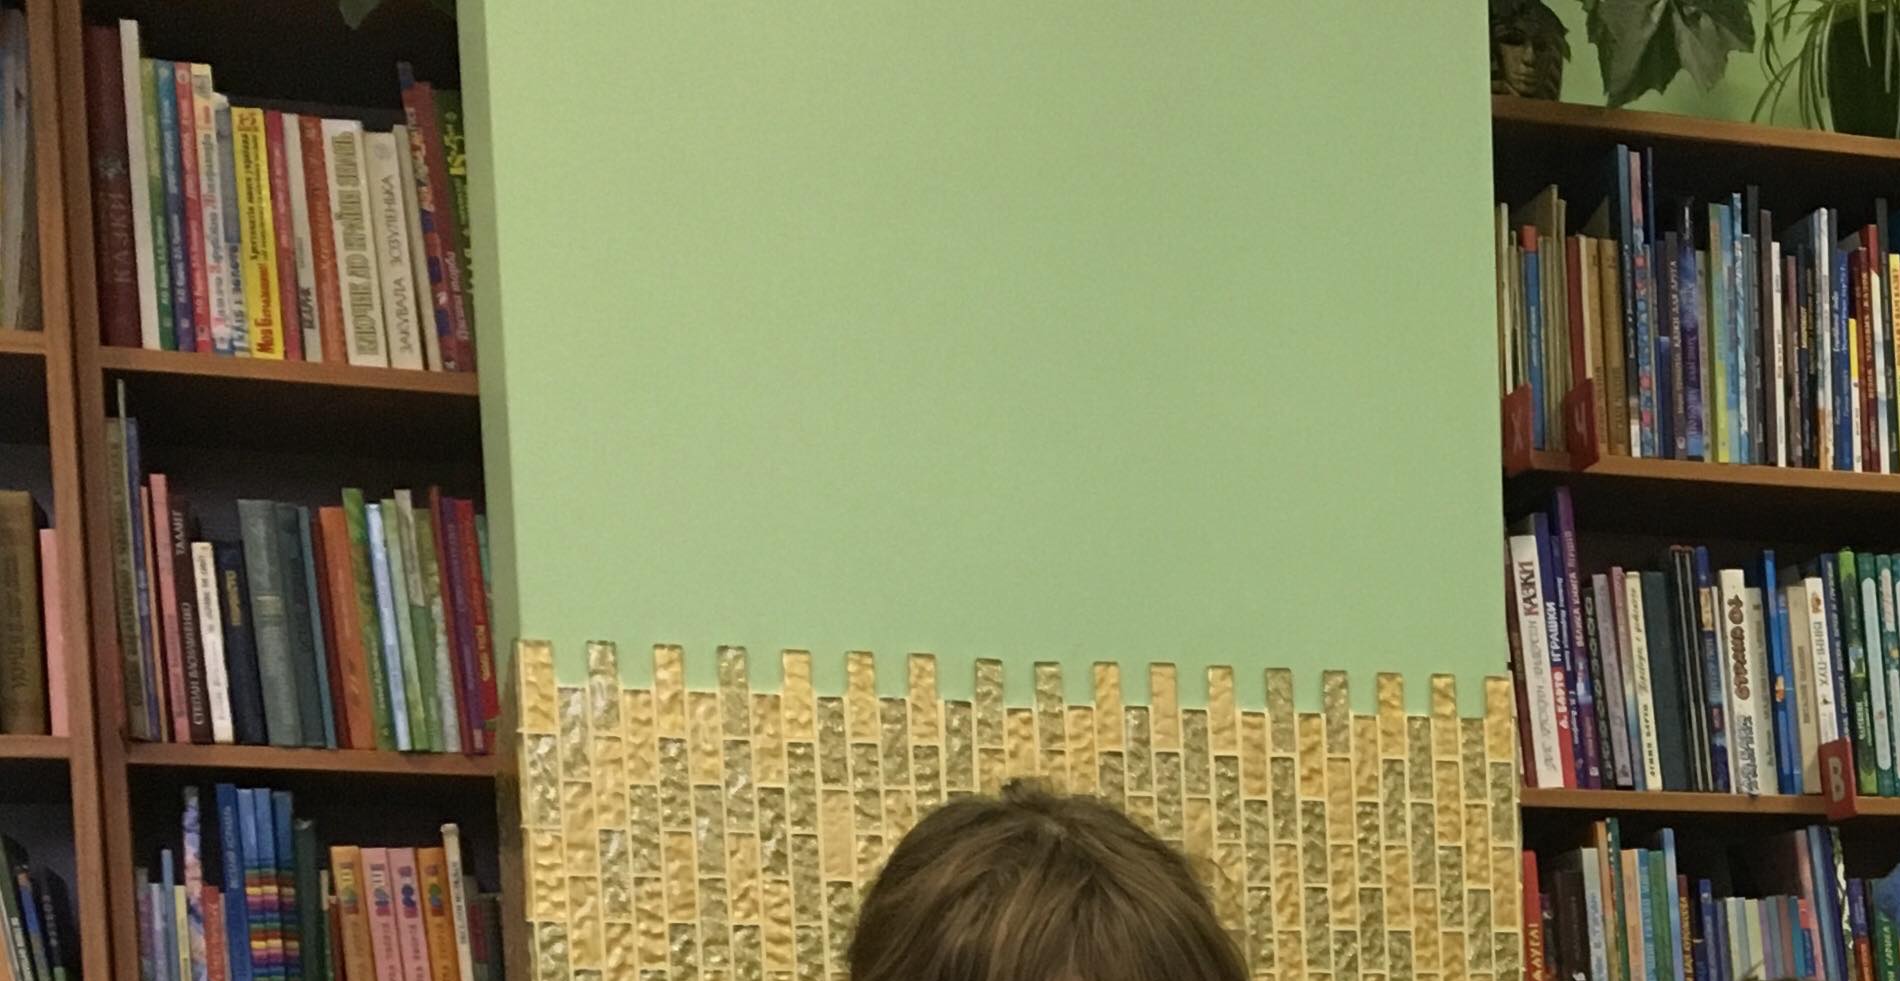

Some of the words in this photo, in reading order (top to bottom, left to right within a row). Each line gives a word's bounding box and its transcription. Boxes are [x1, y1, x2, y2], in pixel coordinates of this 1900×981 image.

[381, 175, 404, 267] ЗОЗУЛЕНЬКА
[392, 277, 413, 354] ЗАКУВАЛА
[172, 510, 187, 556] ТАЛАНТ
[1518, 560, 1540, 617] КАЗКИ
[1546, 601, 1562, 662] ІГРАШКИ
[1572, 607, 1584, 648] ВЕЛИКА
[191, 681, 205, 725] СТЕПАН
[1554, 671, 1568, 711] БАРТО
[1828, 756, 1845, 802] В
[1528, 923, 1543, 981] МАУГЛІ
